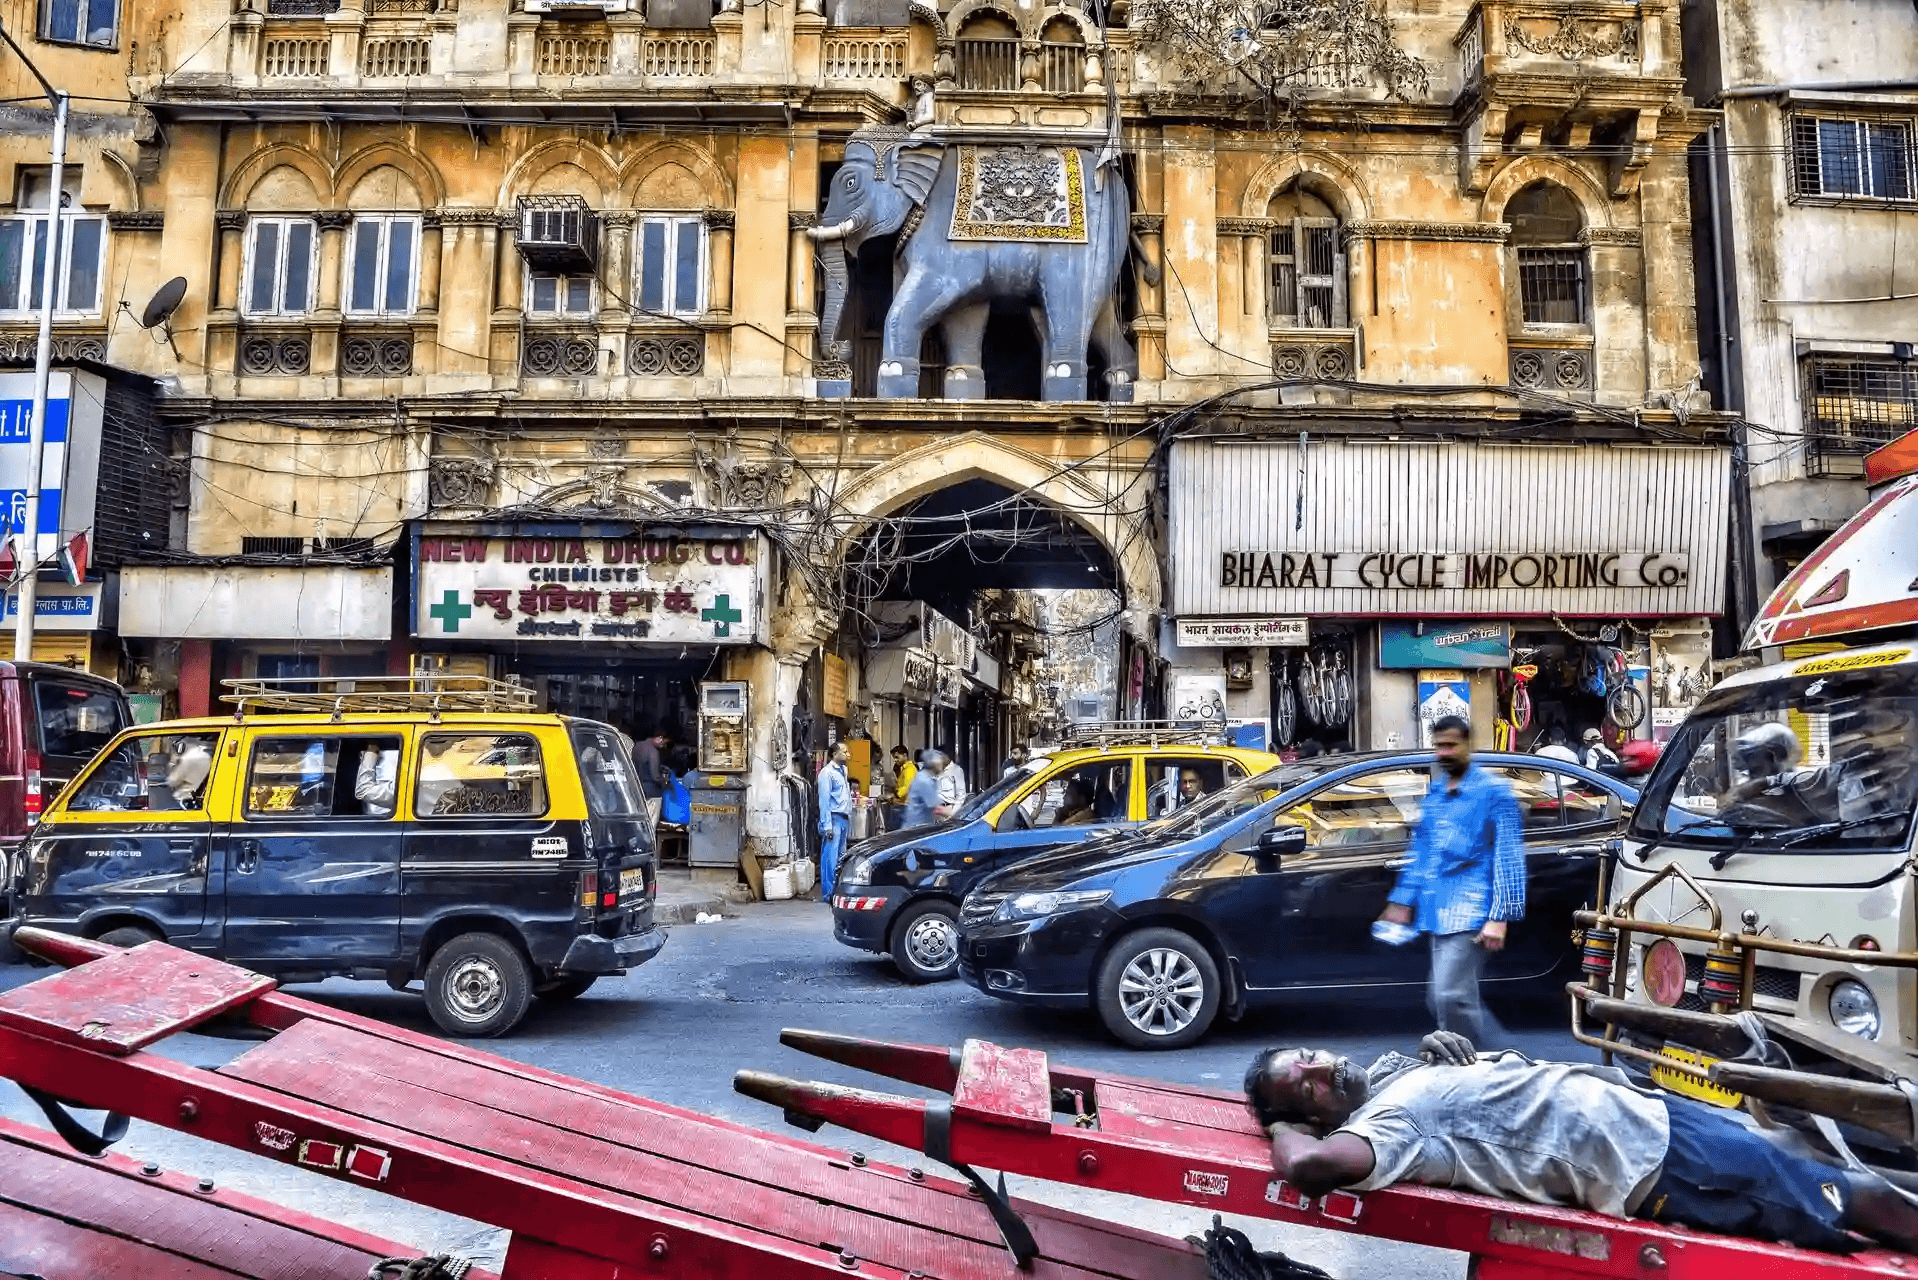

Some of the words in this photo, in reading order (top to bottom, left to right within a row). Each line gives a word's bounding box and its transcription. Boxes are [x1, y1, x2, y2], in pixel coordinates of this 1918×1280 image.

[420, 538, 488, 563] NEW
[503, 538, 588, 564] INDIA
[602, 538, 690, 566] DRUG
[528, 567, 640, 583] CHEMISTS
[1222, 552, 1338, 589] BHARAT
[1358, 553, 1447, 589] CYCLE
[1465, 553, 1620, 589] IMPORTING
[1185, 624, 1208, 636] भारत
[1433, 631, 1470, 648] urban
[1479, 625, 1502, 640] trail
